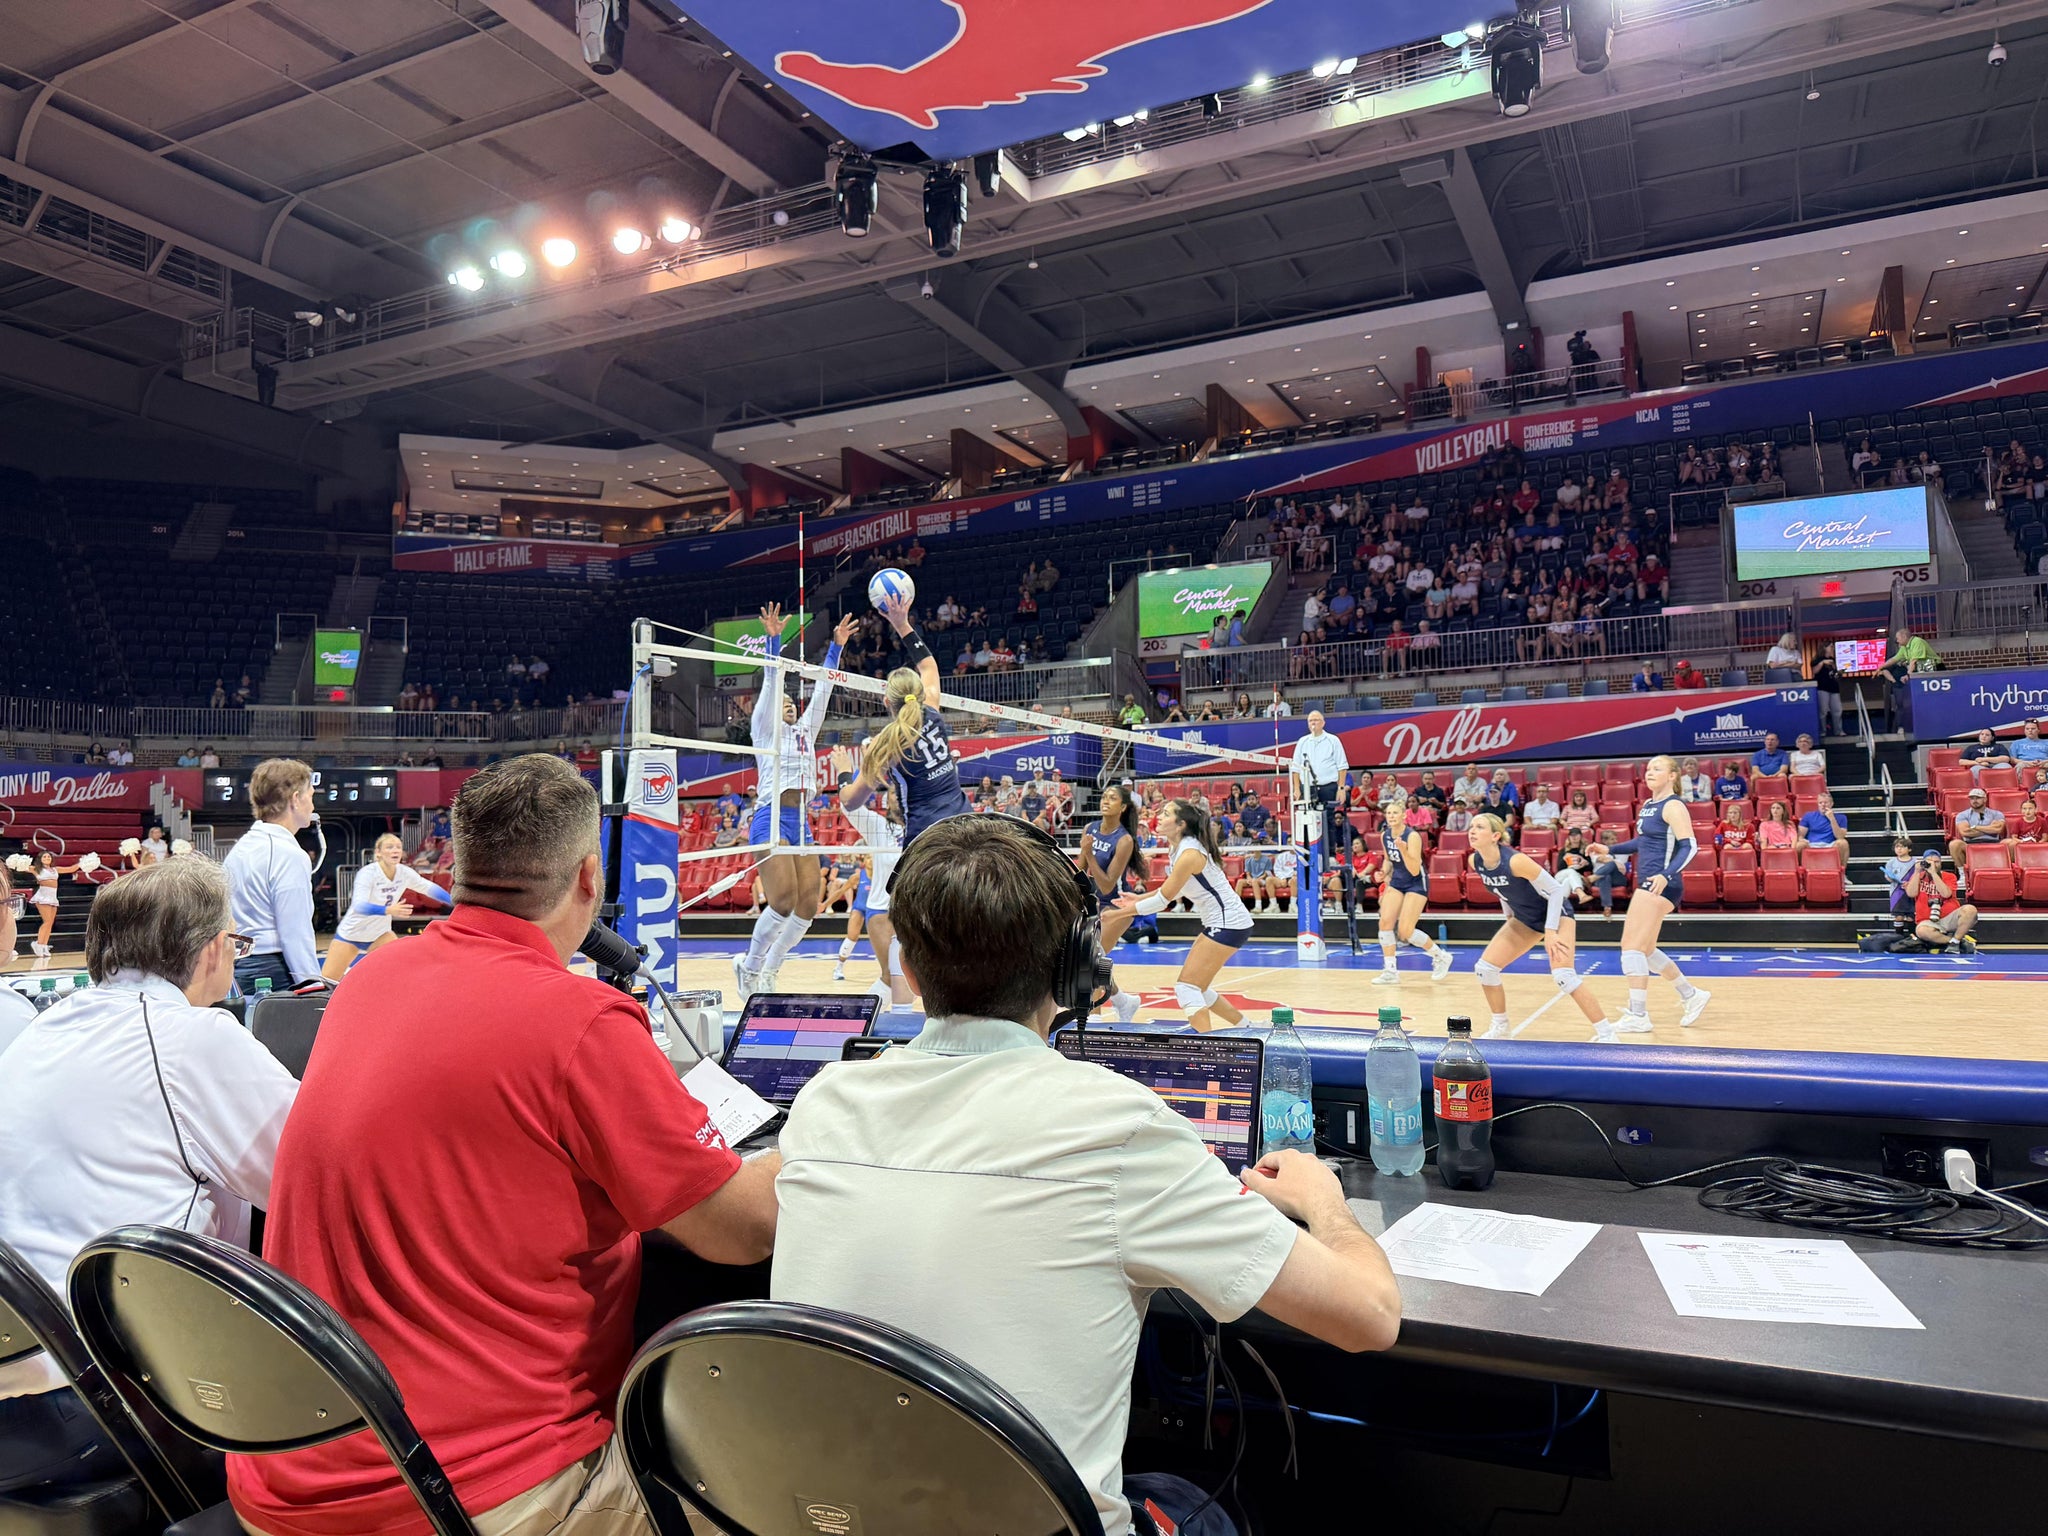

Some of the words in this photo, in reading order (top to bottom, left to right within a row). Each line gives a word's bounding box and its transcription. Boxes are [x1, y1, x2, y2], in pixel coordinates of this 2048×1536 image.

[1636, 408, 1660, 423] NCAA
[1523, 419, 1576, 439] CONFERENCE
[1523, 434, 1573, 452] CHAMPIONS
[1107, 486, 1126, 499] WNIT
[1014, 500, 1032, 512] NCAA
[917, 511, 952, 526] CONFERENCE
[812, 532, 845, 555] WOMEN'S
[844, 510, 912, 550] BASKETBALL
[917, 523, 950, 537] CHAMPIONS
[1783, 514, 1868, 538] Central
[1796, 530, 1892, 552] Market
[454, 550, 487, 572] HALL
[486, 552, 497, 565] OF
[497, 545, 533, 567] FAME
[1173, 584, 1233, 604] Central
[1740, 581, 1777, 598] 204
[1182, 597, 1249, 615] Market
[1143, 639, 1168, 652] 203
[719, 677, 737, 687] 202
[827, 670, 848, 683] SMU
[1921, 679, 1951, 692] 105
[1780, 690, 1810, 702] 104
[1971, 684, 2048, 713] rhythm
[989, 704, 1003, 714] SMU
[2024, 704, 2048, 712] energ
[1050, 717, 1062, 726] SMU
[1052, 735, 1070, 745] 103
[1379, 706, 1517, 766] Dallas
[918, 726, 948, 769] 15
[1016, 756, 1055, 772] SMU
[0, 773, 28, 798] ONY
[32, 771, 50, 794] UP
[48, 771, 129, 806] Dallas
[222, 787, 233, 800] 2
[329, 790, 338, 800] 2
[349, 790, 358, 801] 0
[384, 787, 391, 800] 1
[1724, 830, 1747, 839] SMU
[1091, 838, 1112, 852] ALE
[1480, 873, 1509, 886] YALE
[1268, 1112, 1311, 1136] DASANI
[1629, 1129, 1640, 1140] 4
